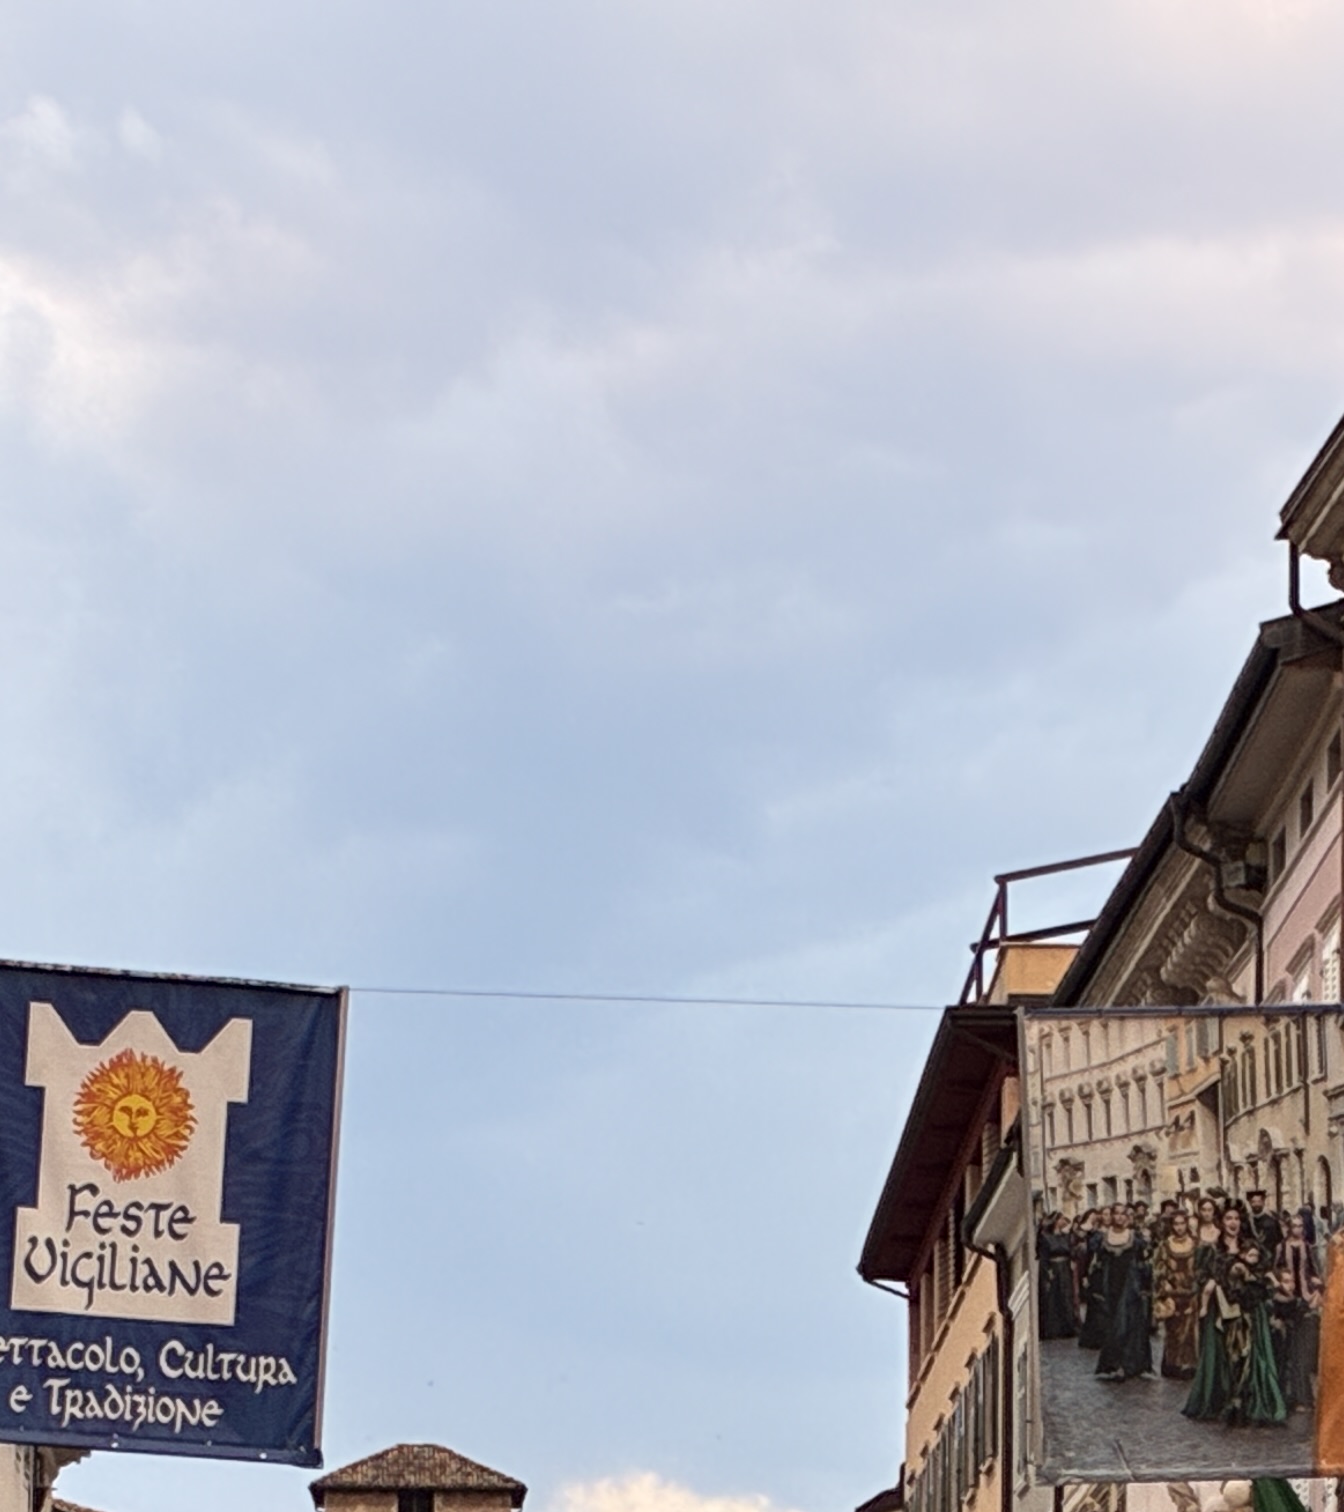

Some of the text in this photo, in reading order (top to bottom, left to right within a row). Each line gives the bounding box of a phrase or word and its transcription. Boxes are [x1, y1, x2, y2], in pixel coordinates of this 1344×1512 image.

[65, 1183, 196, 1241] Feste
[23, 1235, 233, 1309] Vigiliane
[159, 1340, 297, 1394] Cultura
[9, 1378, 224, 1433] e Tradizione
